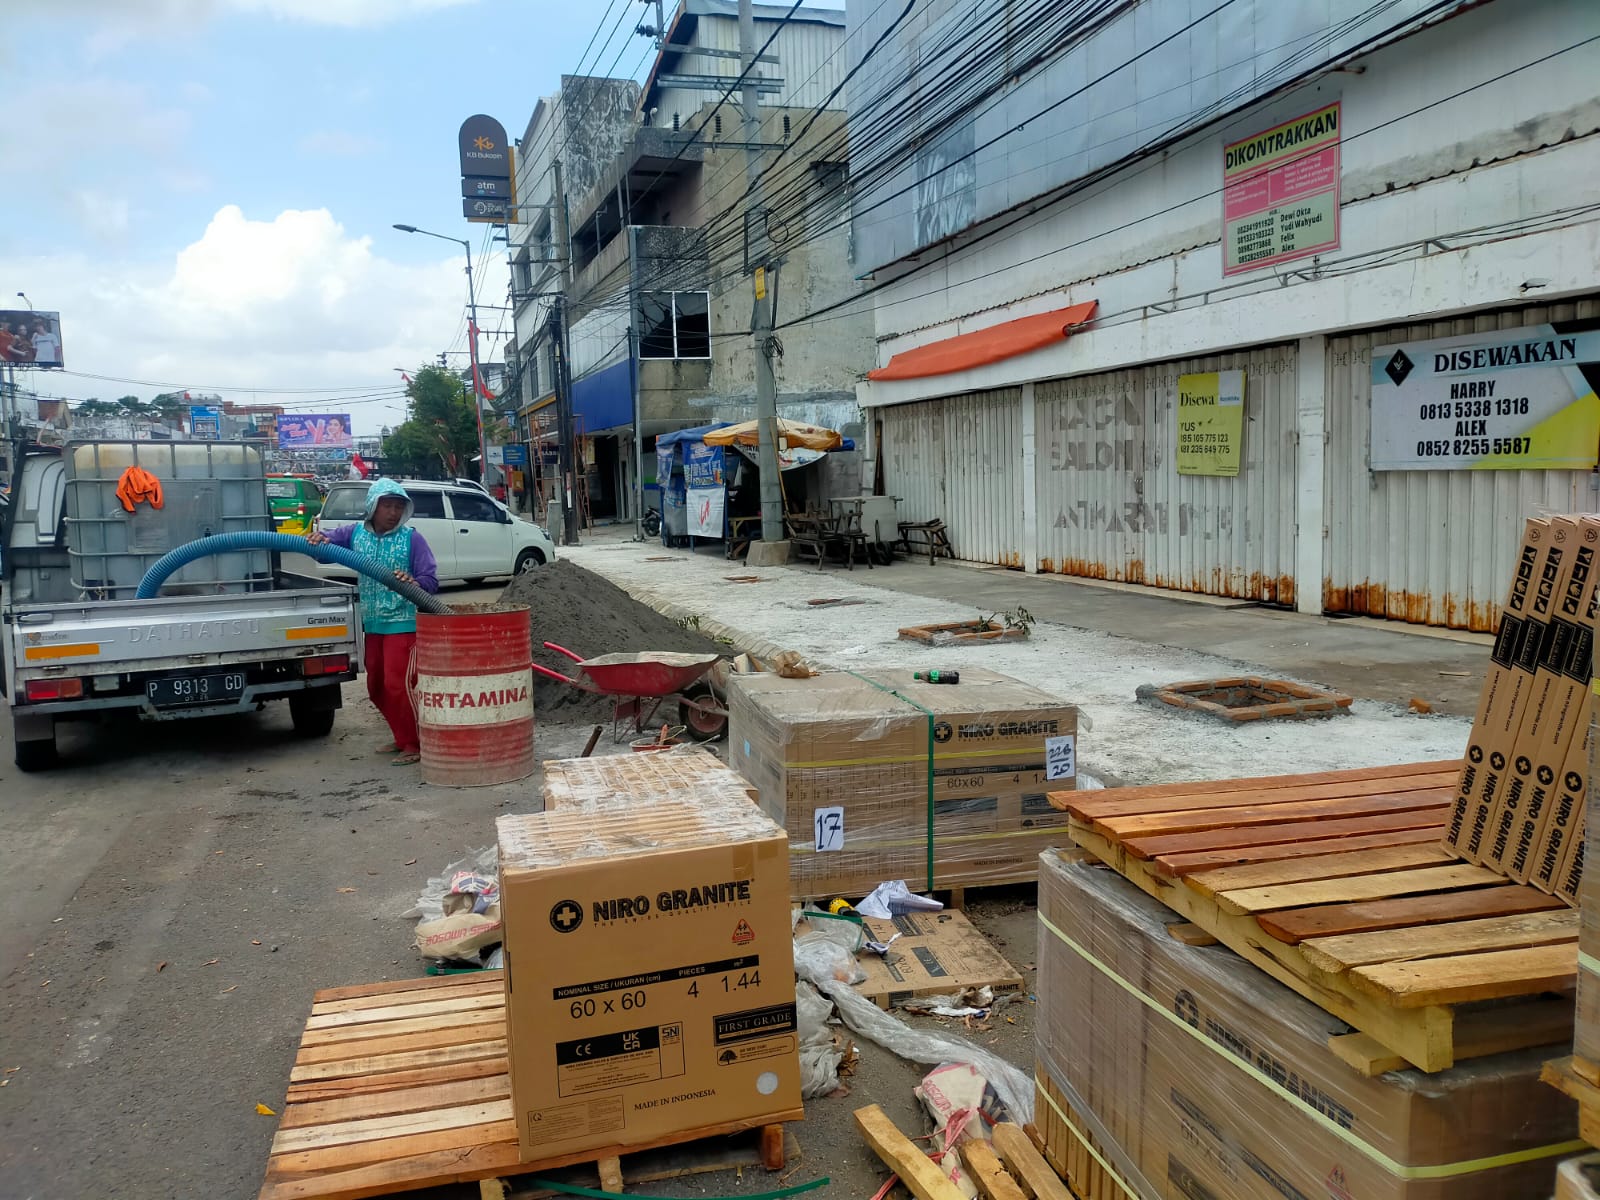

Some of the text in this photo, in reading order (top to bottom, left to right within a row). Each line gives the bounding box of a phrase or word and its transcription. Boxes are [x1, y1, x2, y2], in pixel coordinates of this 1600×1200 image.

[1226, 110, 1337, 170] DIKONTRAKKAN
[1280, 211, 1295, 222] Dewi
[1296, 208, 1311, 218] Okta
[1281, 222, 1294, 232] Yudi
[1295, 213, 1322, 228] Wahyudi
[1281, 233, 1294, 242] Felix
[1282, 244, 1294, 252] Alex
[1434, 338, 1576, 372] DISEWAKAN
[1180, 392, 1214, 406] Disewa
[1450, 380, 1496, 400] HARRY
[1420, 398, 1528, 420] 0813 5338 1318
[1205, 434, 1216, 442] 775
[1218, 434, 1228, 442] 123
[1456, 420, 1487, 437] ALEX
[1218, 445, 1230, 454] 775
[1417, 438, 1531, 456] 0852 8255 5587
[128, 619, 260, 642] DAIHATSU
[148, 675, 242, 698] P 9313 GD
[415, 686, 528, 708] PERTAMINA
[958, 720, 994, 738] NIRO
[998, 719, 1058, 736] GRANITE
[1013, 774, 1020, 785] 4
[1448, 765, 1476, 846] NIRO GRANITE
[1468, 772, 1498, 855] NIRO GRANITE
[1492, 777, 1524, 861] NIRO GRANITE
[1513, 786, 1546, 873] NIRO GRANITE
[816, 813, 841, 850] 17
[1540, 793, 1574, 882] NIRO GRANITE
[593, 880, 750, 922] NIRO GRANITE
[678, 966, 706, 976] PIECES
[558, 986, 592, 996] NOMINAL
[594, 982, 609, 990] SIZE
[614, 978, 644, 987] UKURAN
[646, 974, 660, 983] (cm)
[687, 970, 762, 998] 4 1.44
[570, 990, 646, 1019] 60 x 60
[720, 1012, 792, 1032] FIRST GRADE
[622, 1032, 639, 1041] UK
[624, 1042, 640, 1050] CA
[576, 1044, 592, 1056] CE
[634, 1101, 659, 1111] MADE
[671, 1088, 716, 1104] INDONESIA
